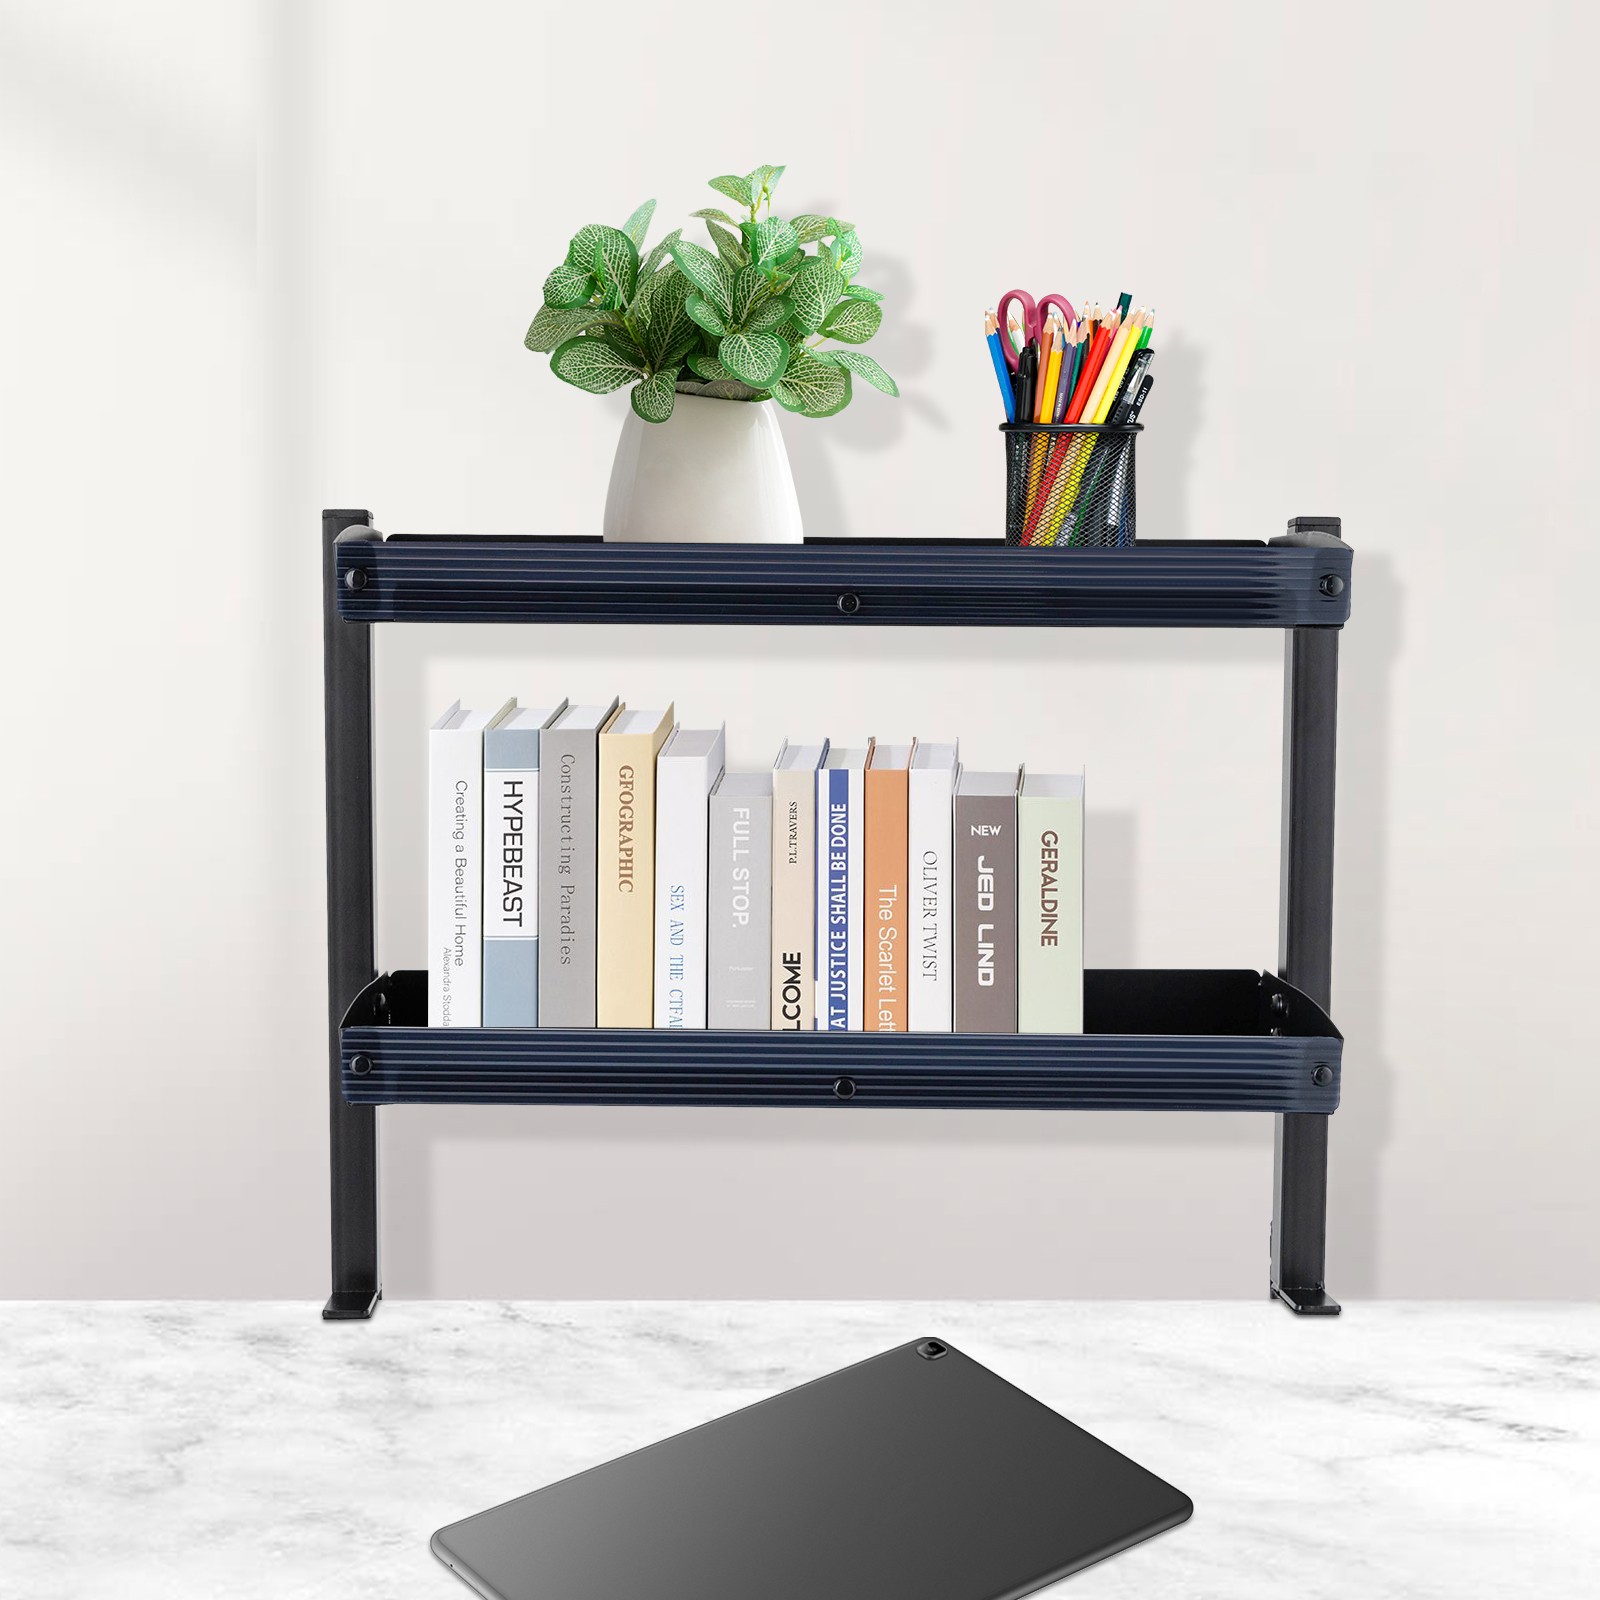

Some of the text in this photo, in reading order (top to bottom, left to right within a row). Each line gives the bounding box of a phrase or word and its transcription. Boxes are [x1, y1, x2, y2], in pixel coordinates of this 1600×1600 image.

[452, 780, 469, 967] Creating a Beautiful Home
[502, 780, 523, 927] HYPEBEAST
[558, 754, 576, 965] Constructing Paradies
[618, 765, 634, 893] GFOGRAPHIC
[731, 807, 750, 928] FULL STOP.
[970, 825, 1002, 837] NEW
[1040, 830, 1058, 947] GERALDINE
[669, 919, 685, 946] AND
[670, 885, 685, 911] SEX
[830, 803, 847, 1029] AT JUSTICE SHALL BE DONE
[879, 884, 897, 921] The
[922, 850, 938, 981] OLIVER TWIST
[977, 855, 994, 987] JED LIND
[442, 947, 452, 993] Alexandra
[669, 955, 684, 980] THE
[879, 925, 897, 992] Scarlet
